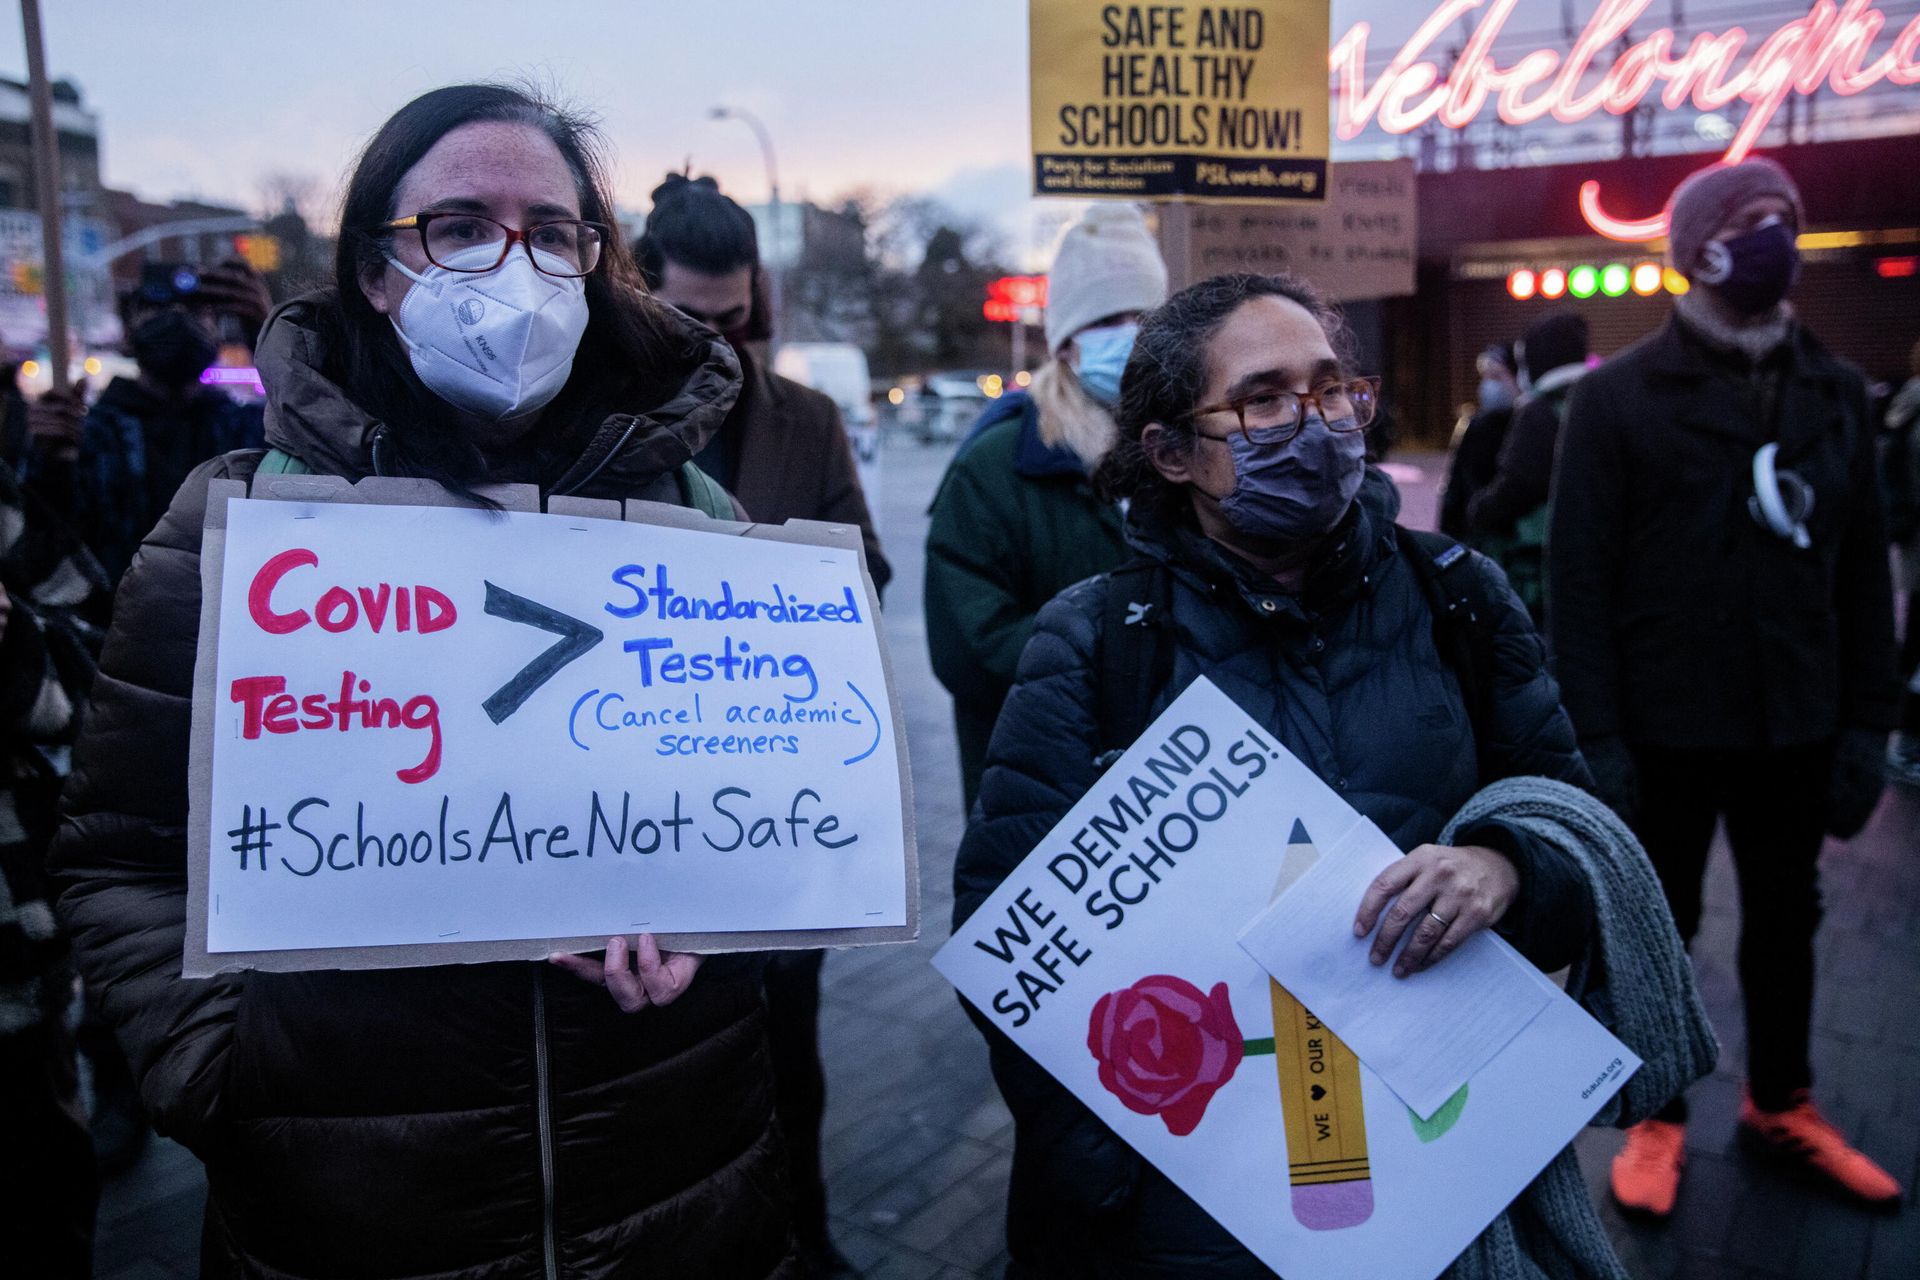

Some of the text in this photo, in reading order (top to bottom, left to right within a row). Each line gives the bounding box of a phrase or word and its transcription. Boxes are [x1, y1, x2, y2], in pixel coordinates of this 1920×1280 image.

[1102, 5, 1265, 52] SAFE AND
[1102, 53, 1256, 101] HEALTHY
[1059, 102, 1304, 151] SCHOOLS NOW!
[1042, 159, 1175, 174] Party for Socialism
[1043, 174, 1146, 189] and Liberation
[1195, 162, 1319, 193] PSLweb.org
[475, 335, 497, 361] KN95
[604, 563, 863, 624] Standardized
[622, 635, 819, 703] Testing
[230, 671, 442, 784] Testing
[973, 724, 1211, 964] WE DEMAND
[991, 728, 1280, 1029] SAFE SCHOOLS!
[1305, 1007, 1332, 1142] WE OUR KI
[1581, 1057, 1623, 1100] dsausa.org
